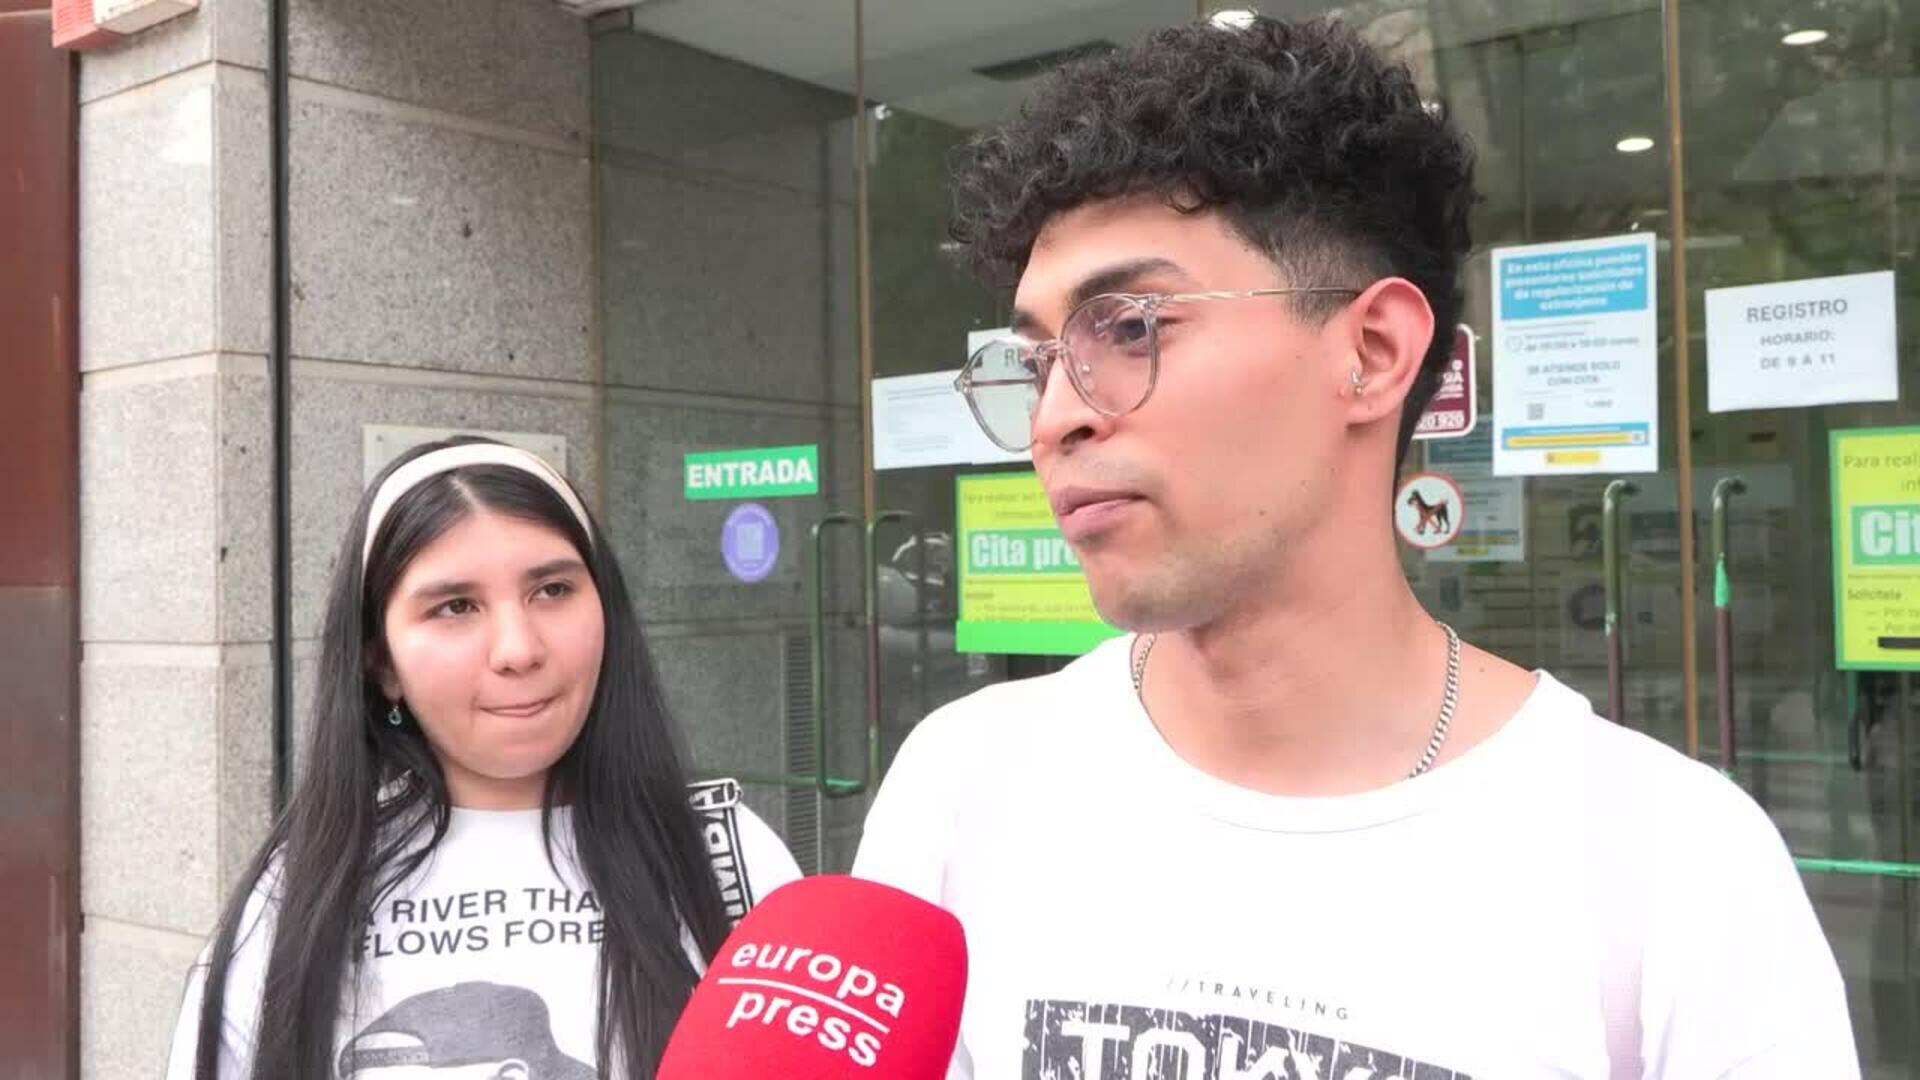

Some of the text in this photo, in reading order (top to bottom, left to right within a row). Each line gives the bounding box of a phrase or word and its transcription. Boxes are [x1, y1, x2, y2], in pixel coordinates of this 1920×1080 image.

[1747, 298, 1848, 323] REGISTRO
[1760, 329, 1836, 346] HORARIO:
[1760, 357, 1780, 369] DE
[1803, 354, 1812, 366] A
[1820, 352, 1835, 365] 11
[688, 457, 814, 488] ENTRADA
[1844, 455, 1880, 469] Para
[972, 533, 1027, 568] Cita
[391, 889, 507, 924] RIVER
[731, 943, 905, 1018] europa
[725, 991, 881, 1067] press
